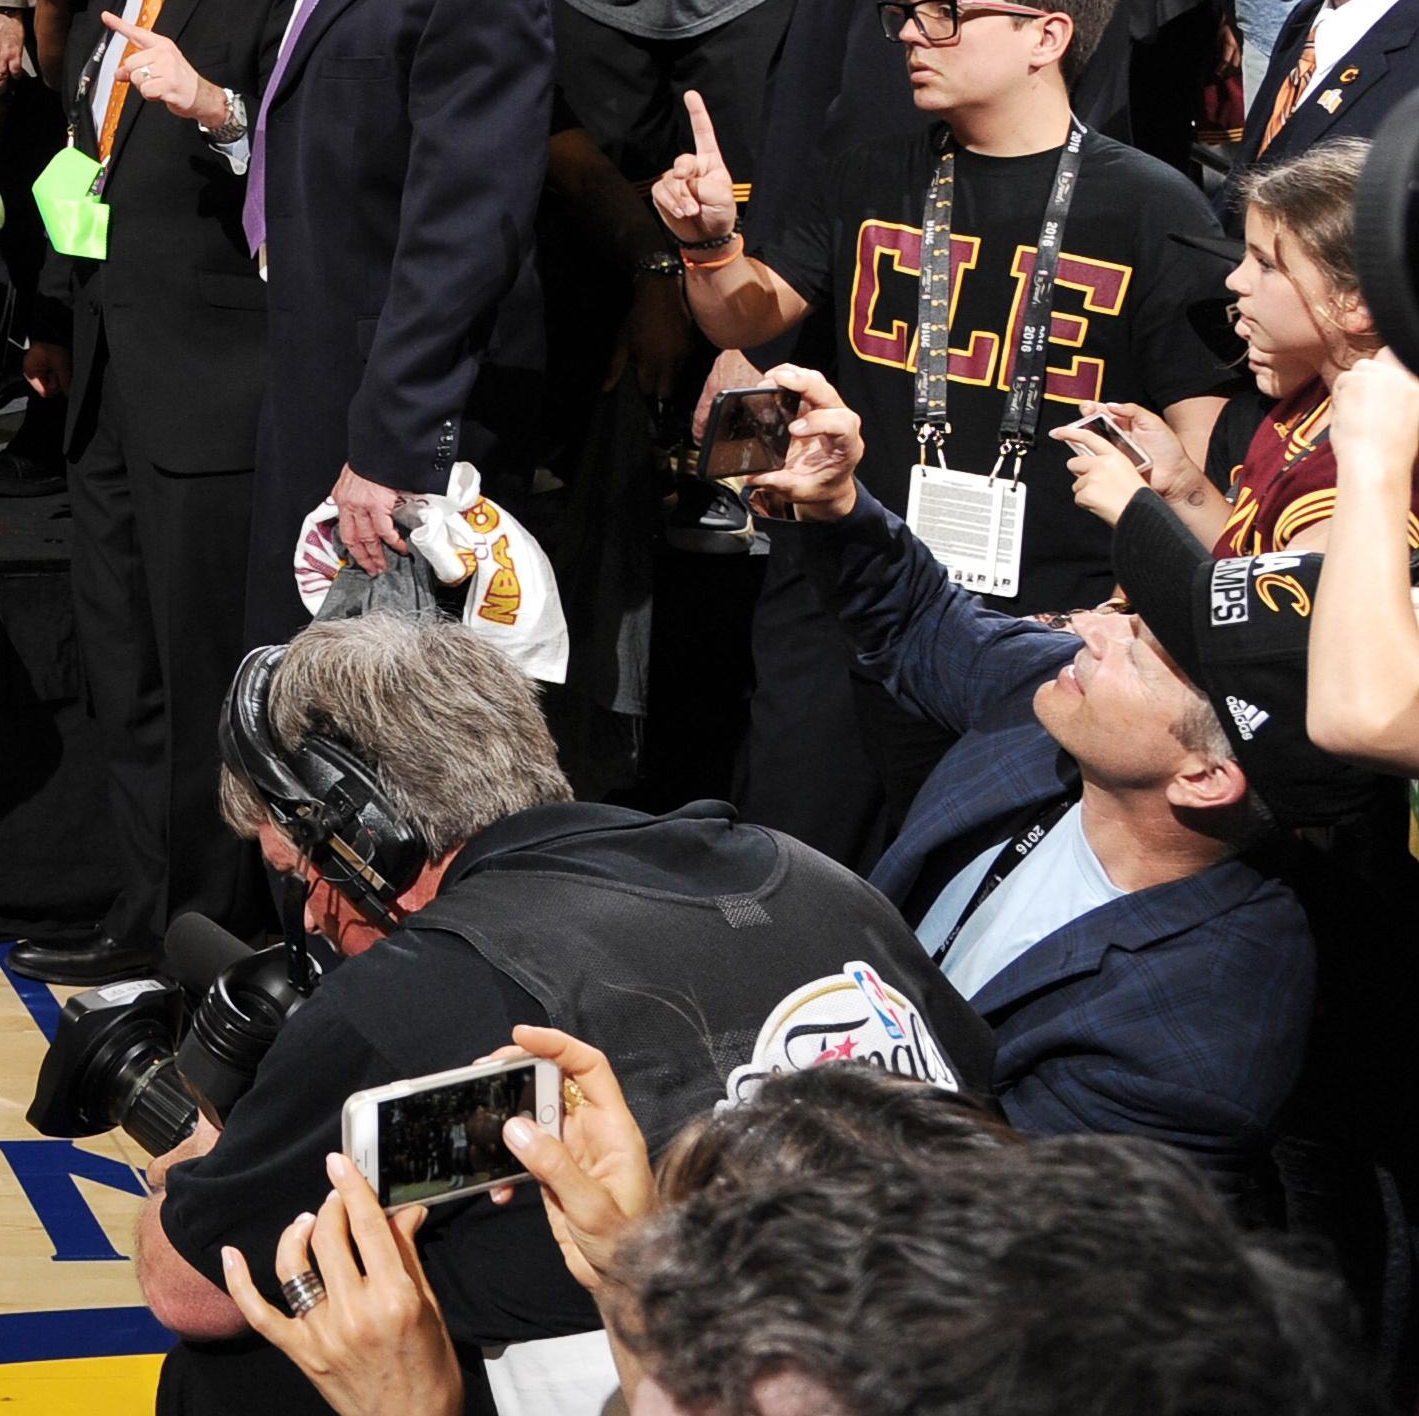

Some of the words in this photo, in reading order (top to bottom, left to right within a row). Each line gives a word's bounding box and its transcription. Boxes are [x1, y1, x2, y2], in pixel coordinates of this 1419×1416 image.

[1042, 221, 1059, 248] 2016
[849, 218, 1134, 405] CLE
[1021, 325, 1036, 353] 2016
[1213, 559, 1250, 625] AMPS
[1015, 824, 1046, 856] 2016
